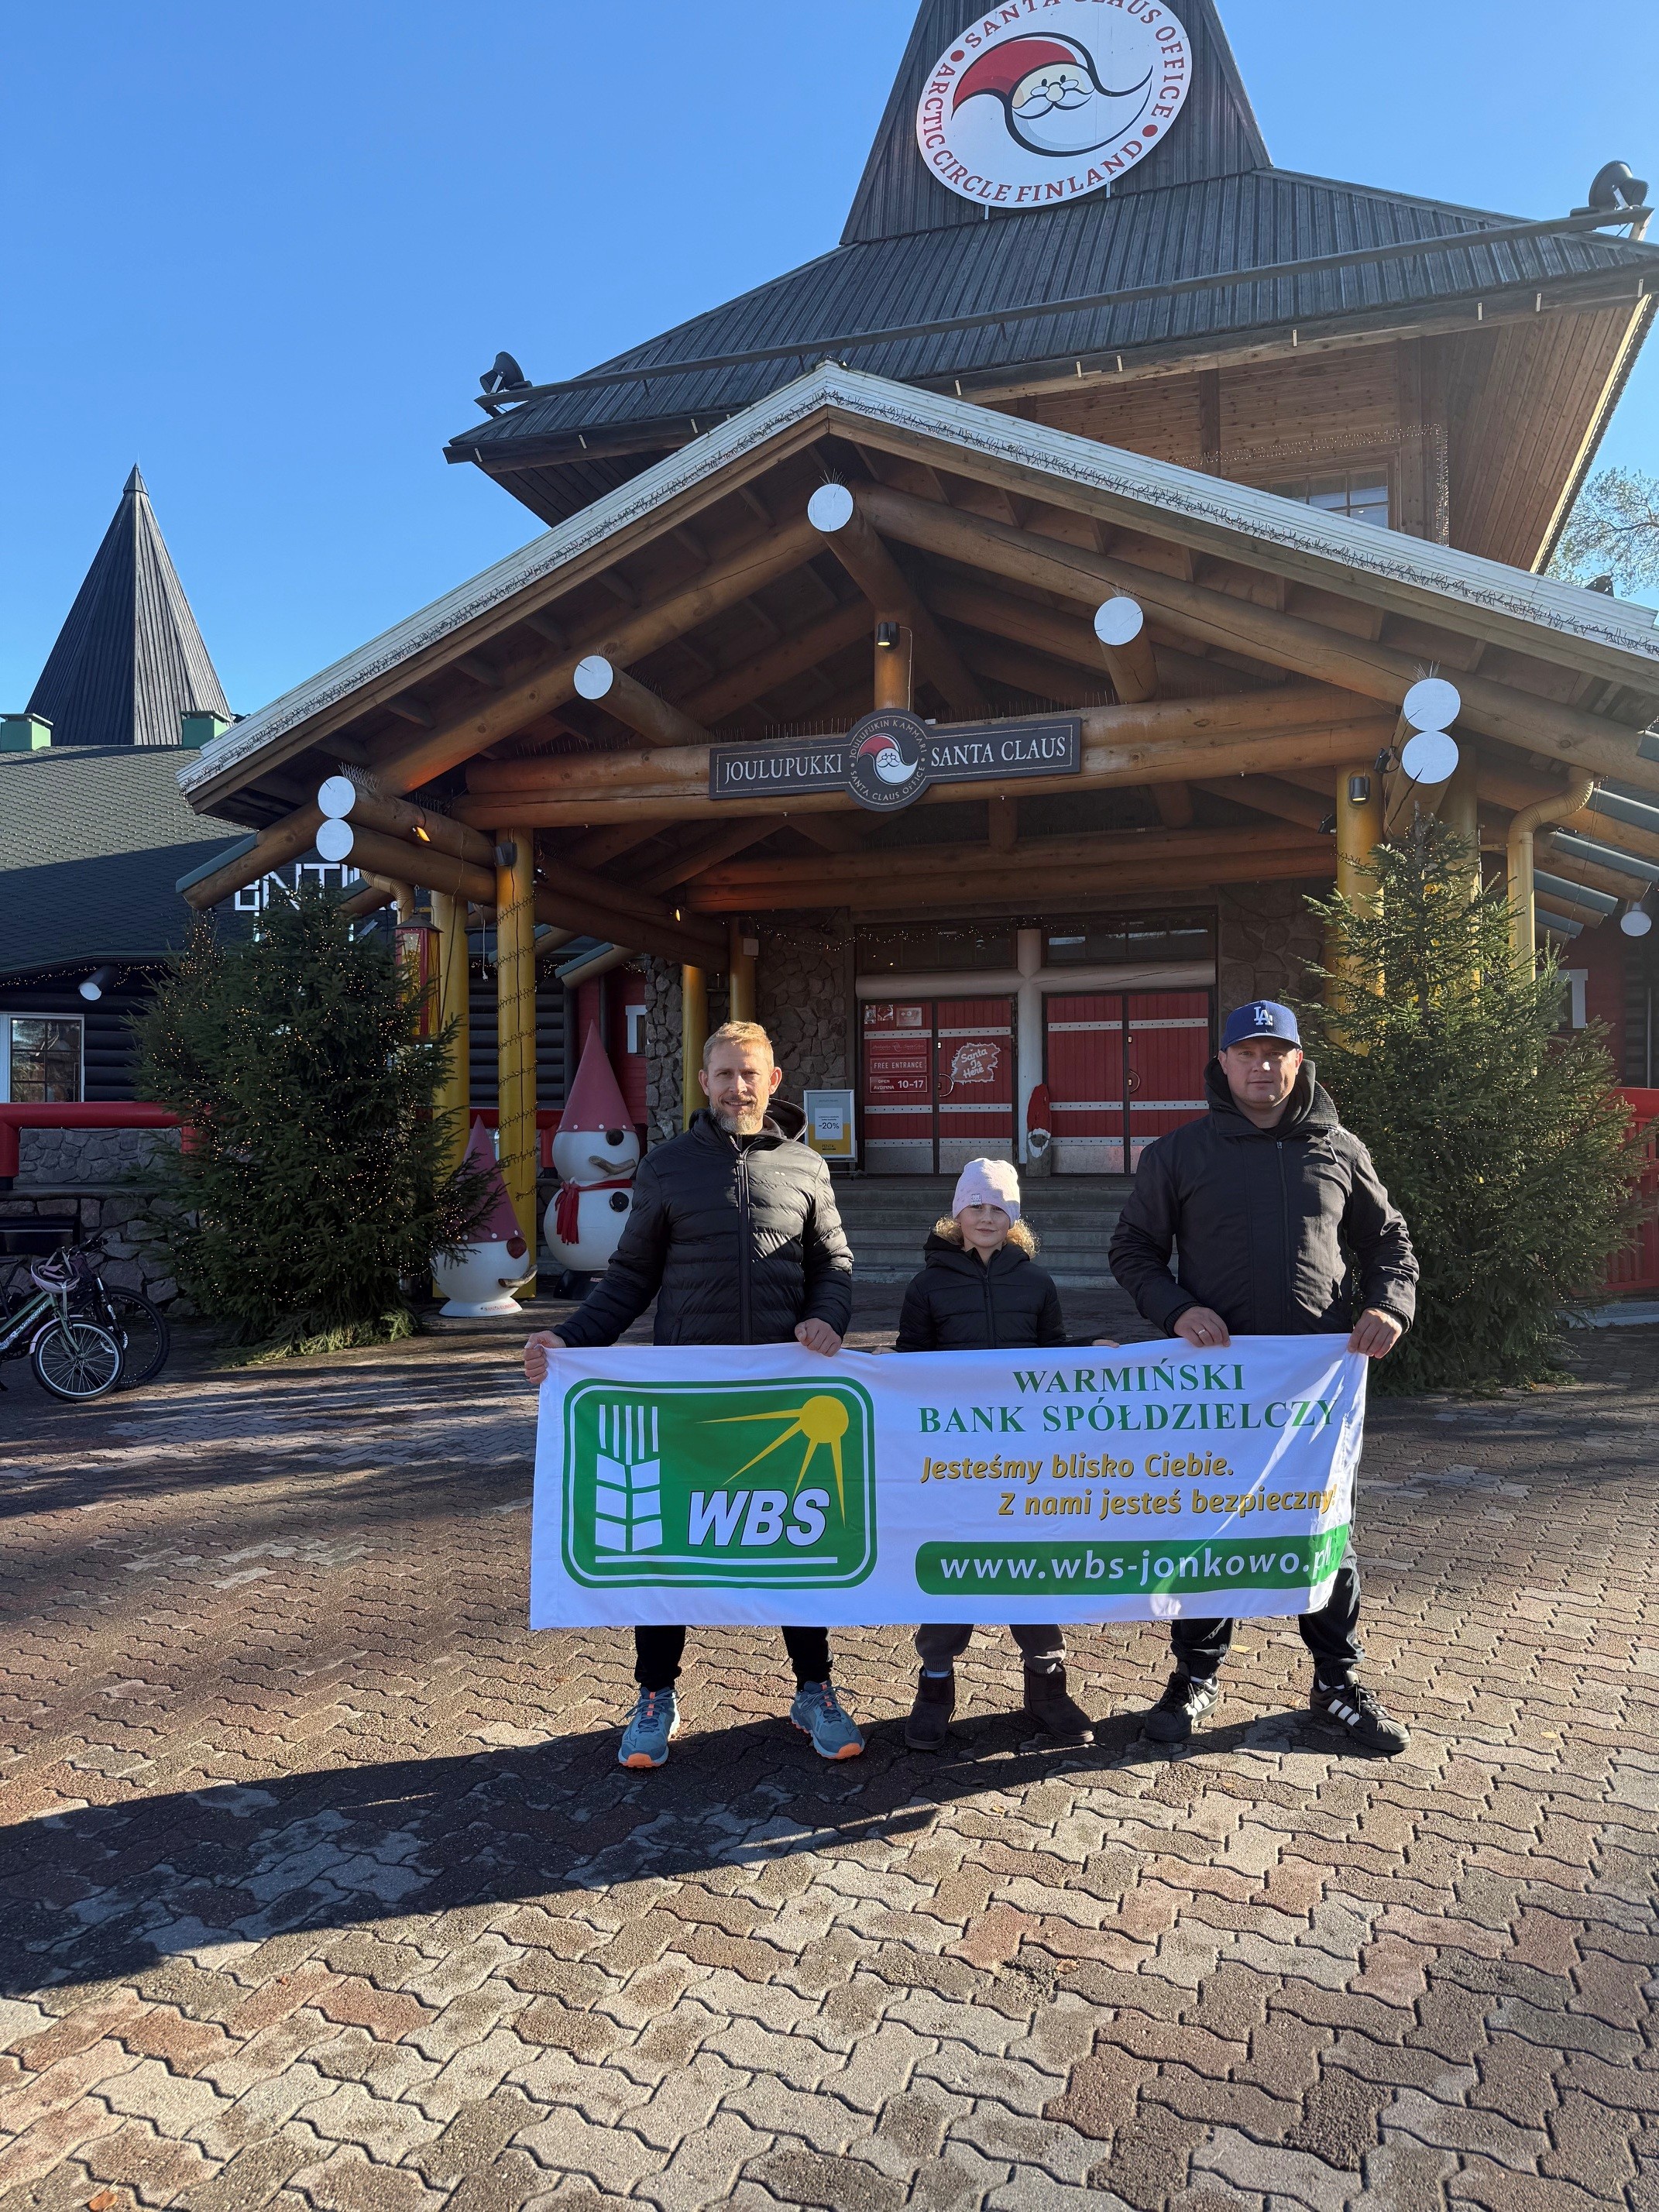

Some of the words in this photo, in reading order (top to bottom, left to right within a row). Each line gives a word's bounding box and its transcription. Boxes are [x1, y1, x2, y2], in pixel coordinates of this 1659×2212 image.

[1151, 26, 1185, 119] OFFICE
[923, 62, 956, 149] ARCTIC
[933, 149, 1011, 202] CIRCLE
[1015, 139, 1142, 202] FINLAND
[850, 720, 889, 759] JOULUPUKIN
[893, 720, 927, 753] KAMMARI
[931, 744, 994, 768] SANTA
[1001, 737, 1066, 761] CLAUS
[724, 754, 843, 785] JOULUPUKKI
[850, 771, 868, 796] SANTA
[872, 792, 900, 801] CLAUS
[902, 766, 926, 794] OFFICE
[1253, 1006, 1273, 1026] LA
[960, 1049, 988, 1063] Santa
[963, 1066, 984, 1078] Here
[1012, 1358, 1245, 1394] WARMIŃSKI
[918, 1406, 1024, 1434] BANK
[1042, 1396, 1338, 1434] SPÓŁDZIELCZY
[920, 1454, 1043, 1485] Jesteśmy
[1052, 1452, 1134, 1479] blisko
[1144, 1450, 1234, 1477] Ciebie.
[687, 1487, 831, 1548] WBS
[998, 1492, 1015, 1516] Z
[1024, 1489, 1092, 1516] nami
[1099, 1488, 1182, 1520] jesteś
[1190, 1484, 1338, 1518] bezpieczny!
[939, 1536, 1332, 1586] www.wbs-jonkowo.pl
